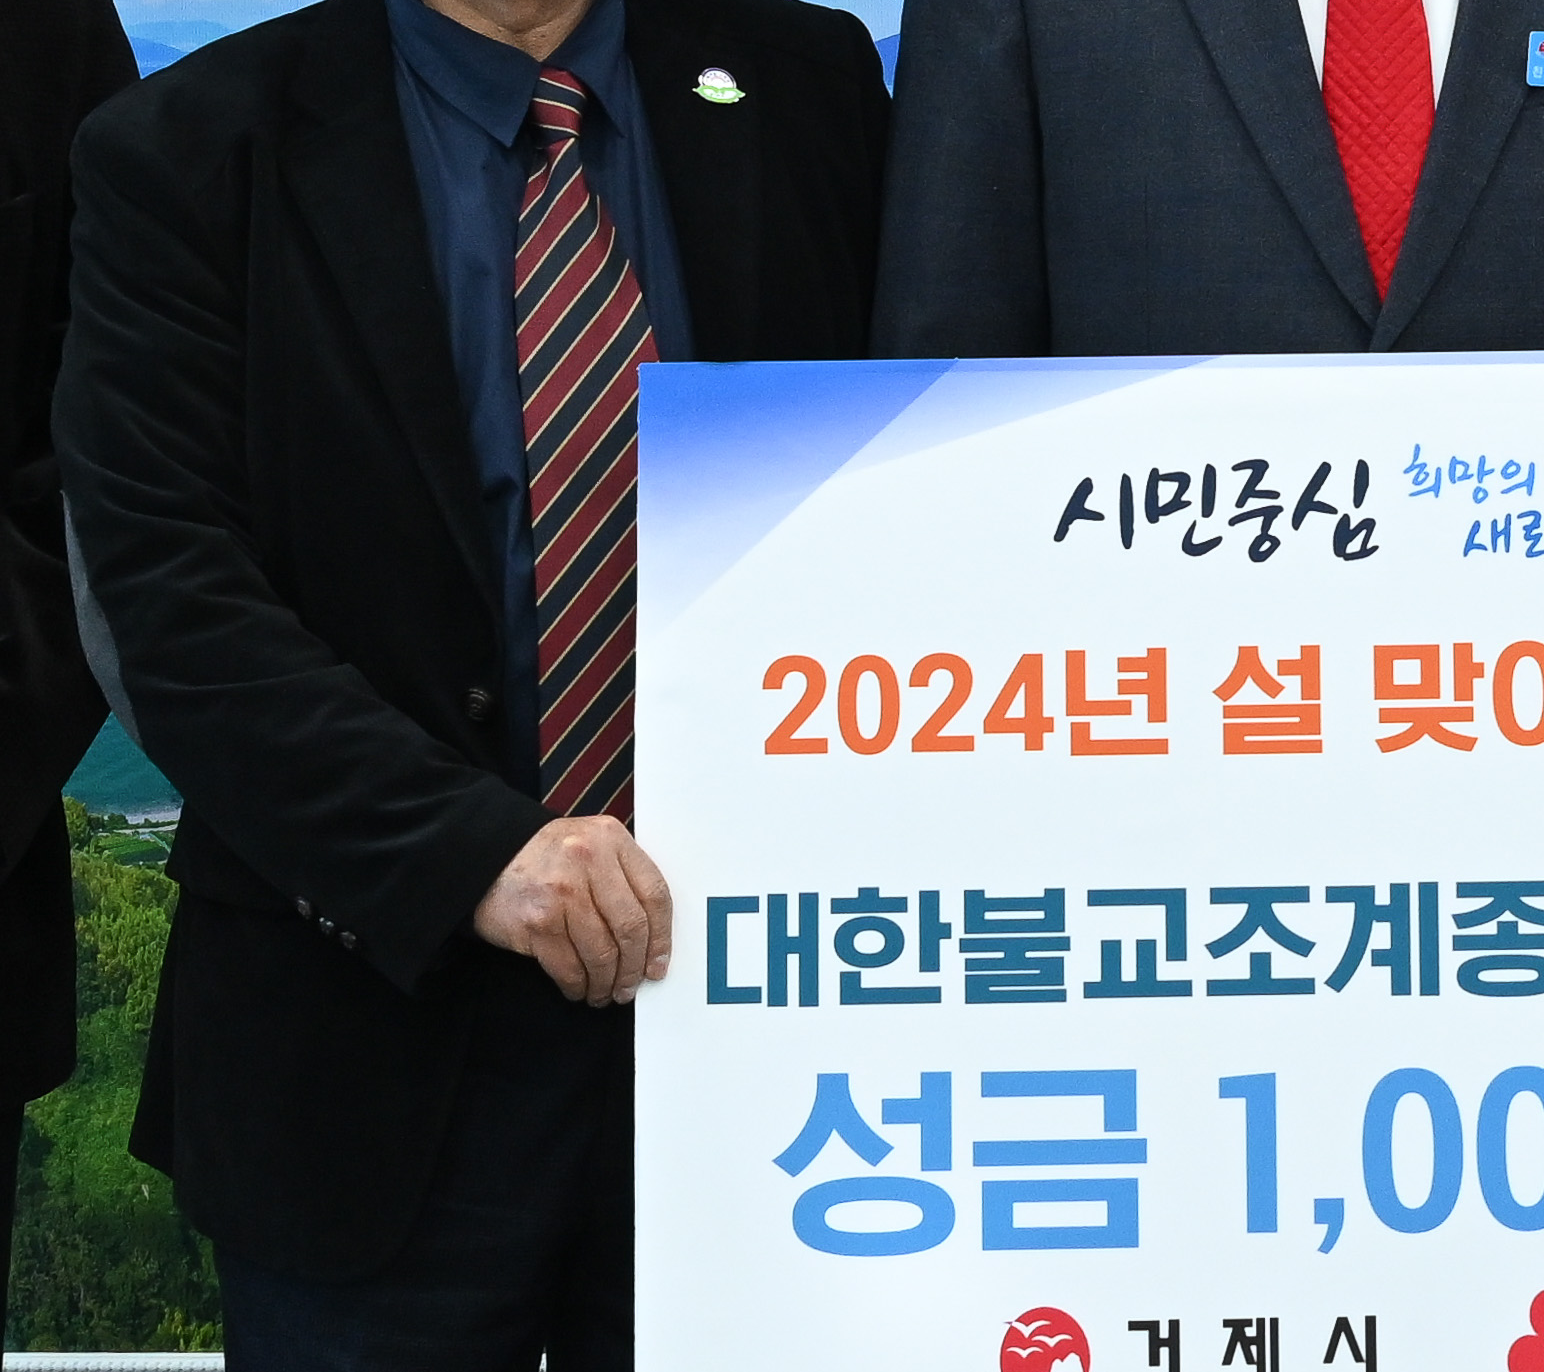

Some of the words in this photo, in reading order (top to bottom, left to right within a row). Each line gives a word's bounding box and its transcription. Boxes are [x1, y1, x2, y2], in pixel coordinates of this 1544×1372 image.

[1054, 459, 1379, 562] 시민중심
[1403, 442, 1536, 504] 희망의
[763, 648, 1170, 756] 2024년
[1213, 645, 1328, 755] 설
[772, 1069, 1148, 1257] 성금
